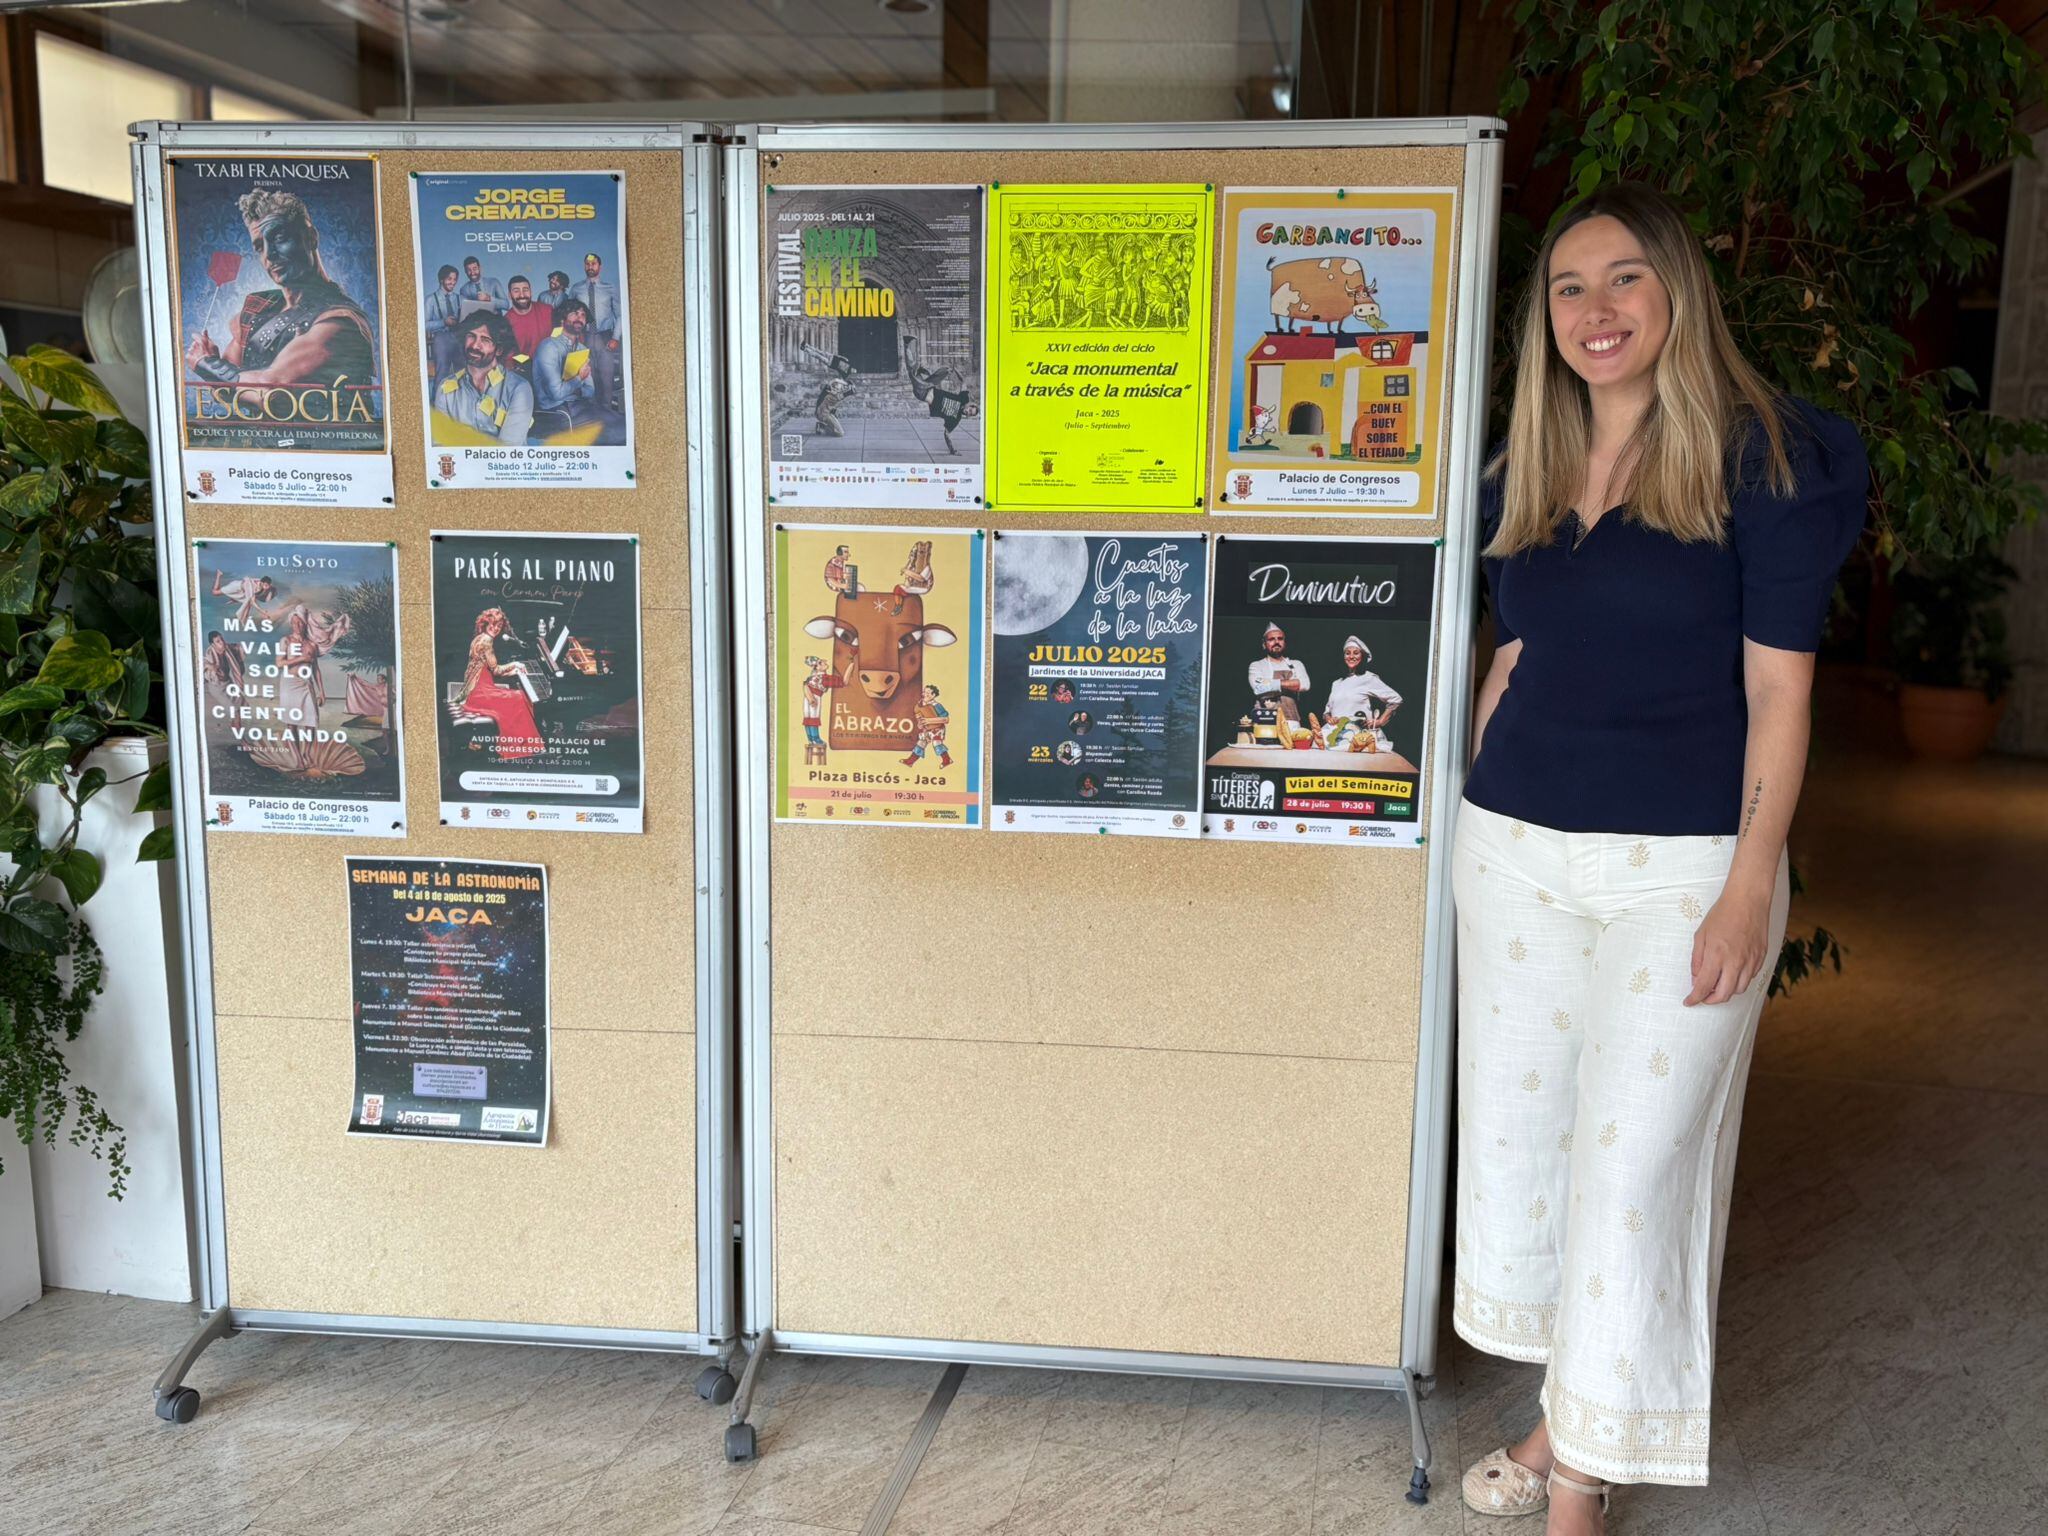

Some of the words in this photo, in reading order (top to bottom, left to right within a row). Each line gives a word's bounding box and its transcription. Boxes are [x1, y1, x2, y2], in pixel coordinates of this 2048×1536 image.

[194, 163, 244, 177] TXABI
[248, 163, 350, 182] FRANQUESA
[474, 188, 566, 204] JORGE
[445, 204, 596, 220] CREMADES
[778, 213, 800, 222] JULIO
[802, 213, 825, 222] 2025
[831, 213, 848, 222] DEL
[853, 213, 864, 221] AL
[865, 213, 875, 221] 21
[465, 231, 574, 242] DESEMPLEADO
[803, 228, 878, 258] DANZA
[487, 244, 513, 253] DEL
[515, 243, 553, 252] MES
[778, 229, 801, 317] FESTIVAL
[804, 257, 832, 287] EN
[840, 257, 865, 287] EL
[804, 288, 895, 318] CAMINO
[1045, 343, 1070, 353] XXVI
[1073, 343, 1109, 353] edición
[1112, 343, 1129, 353] del
[1131, 344, 1155, 353] ciclo
[1073, 362, 1178, 376] monumental
[1010, 388, 1020, 397] a
[1024, 383, 1074, 397] través
[1079, 384, 1100, 397] de
[1104, 384, 1118, 398] la
[194, 374, 375, 423] ESCOCÍA
[1075, 410, 1094, 419] Jaca
[1101, 410, 1120, 418] 2025
[1392, 403, 1403, 413] EL
[1090, 422, 1131, 430] Septiembre)
[1371, 417, 1395, 429] BUEY
[230, 429, 236, 437] Y
[282, 430, 295, 439] LA
[296, 431, 320, 439] EDAD
[1366, 433, 1398, 444] SOBRE
[465, 449, 506, 459] Palacio
[509, 449, 524, 459] de
[526, 449, 590, 462] Congresos
[1358, 447, 1368, 458] EL
[1369, 447, 1405, 458] TEJADO
[487, 462, 520, 471] Sábado
[522, 462, 532, 470] 12
[534, 462, 555, 471] Julio
[566, 462, 590, 471] 22:00
[592, 462, 597, 470] h
[228, 467, 271, 479] Palacio
[273, 468, 287, 479] de
[290, 469, 353, 483] Congresos
[1279, 473, 1320, 484] Palacio
[1323, 474, 1337, 484] de
[1341, 474, 1400, 487] Congresos
[243, 481, 276, 491] Sábado
[278, 482, 284, 491] 5
[285, 482, 307, 492] Julio
[316, 483, 340, 492] 22:00
[341, 484, 347, 493] h
[1292, 487, 1318, 495] Lunes
[1319, 487, 1324, 495] 7
[1325, 487, 1347, 496] Julio
[1356, 487, 1378, 496] 19:30
[1379, 487, 1385, 496] h
[454, 551, 512, 580] PARÍS
[522, 558, 544, 581] AL
[555, 559, 615, 583] PIANO
[1095, 539, 1189, 593] Cuentos
[1249, 563, 1396, 605] Diminutivo
[1094, 591, 1111, 605] a
[1116, 581, 1141, 611] la
[1146, 581, 1191, 620] luz
[223, 616, 274, 633] MÁS
[1087, 610, 1111, 643] de
[1116, 612, 1141, 641] la
[1146, 611, 1198, 640] luna
[240, 642, 303, 656] VALE
[1028, 645, 1103, 663] JULIO
[1107, 646, 1167, 664] 2025
[248, 664, 312, 679] SOLO
[1030, 667, 1066, 676] Jardines
[1067, 668, 1078, 676] de
[1079, 668, 1088, 676] la
[1089, 668, 1140, 677] Universidad
[1141, 669, 1163, 678] JACA
[226, 684, 274, 699] QUE
[1028, 683, 1048, 696] 22
[212, 705, 303, 721] CIENTO
[836, 703, 851, 714] EL
[833, 715, 914, 734] ABRAZO
[231, 727, 347, 743] VOLANDO
[471, 735, 524, 745] AUDITORIO
[528, 736, 546, 745] DEL
[548, 737, 591, 746] PALACIO
[593, 738, 606, 746] DE
[488, 745, 546, 754] CONGRESOS
[564, 747, 589, 755] JACA
[1031, 745, 1050, 758] 23
[809, 770, 848, 782] Plaza
[853, 772, 900, 784] Biscós
[914, 774, 947, 786] Jaca
[1211, 775, 1260, 795] TÍTERES
[1289, 778, 1314, 789] Vial
[1318, 778, 1338, 789] del
[1341, 779, 1408, 794] Seminario
[831, 790, 840, 798] 21
[841, 790, 852, 799] de
[853, 791, 872, 800] julio
[894, 792, 917, 800] 19:30
[249, 798, 289, 810] Palacio
[292, 800, 305, 811] de
[308, 801, 369, 814] Congresos
[1286, 799, 1297, 807] 28
[1299, 800, 1310, 808] de
[1311, 800, 1330, 810] julio
[1341, 801, 1364, 810] 19:30
[1365, 802, 1372, 810] h
[1387, 803, 1407, 812] Jaca
[264, 812, 295, 821] Sábado
[298, 813, 307, 821] 18
[309, 813, 330, 822] Julio
[339, 814, 361, 823] 22:00
[364, 815, 369, 823] h
[352, 869, 407, 885] SEMANA
[413, 871, 429, 885] DE
[434, 872, 451, 887] LA
[392, 889, 407, 899] Del
[407, 890, 414, 900] 4
[414, 890, 423, 900] al
[424, 891, 431, 900] 8
[432, 891, 442, 901] de
[444, 892, 472, 903] agosto
[473, 893, 484, 903] de
[485, 893, 506, 904] 2025
[405, 906, 493, 926] JACA
